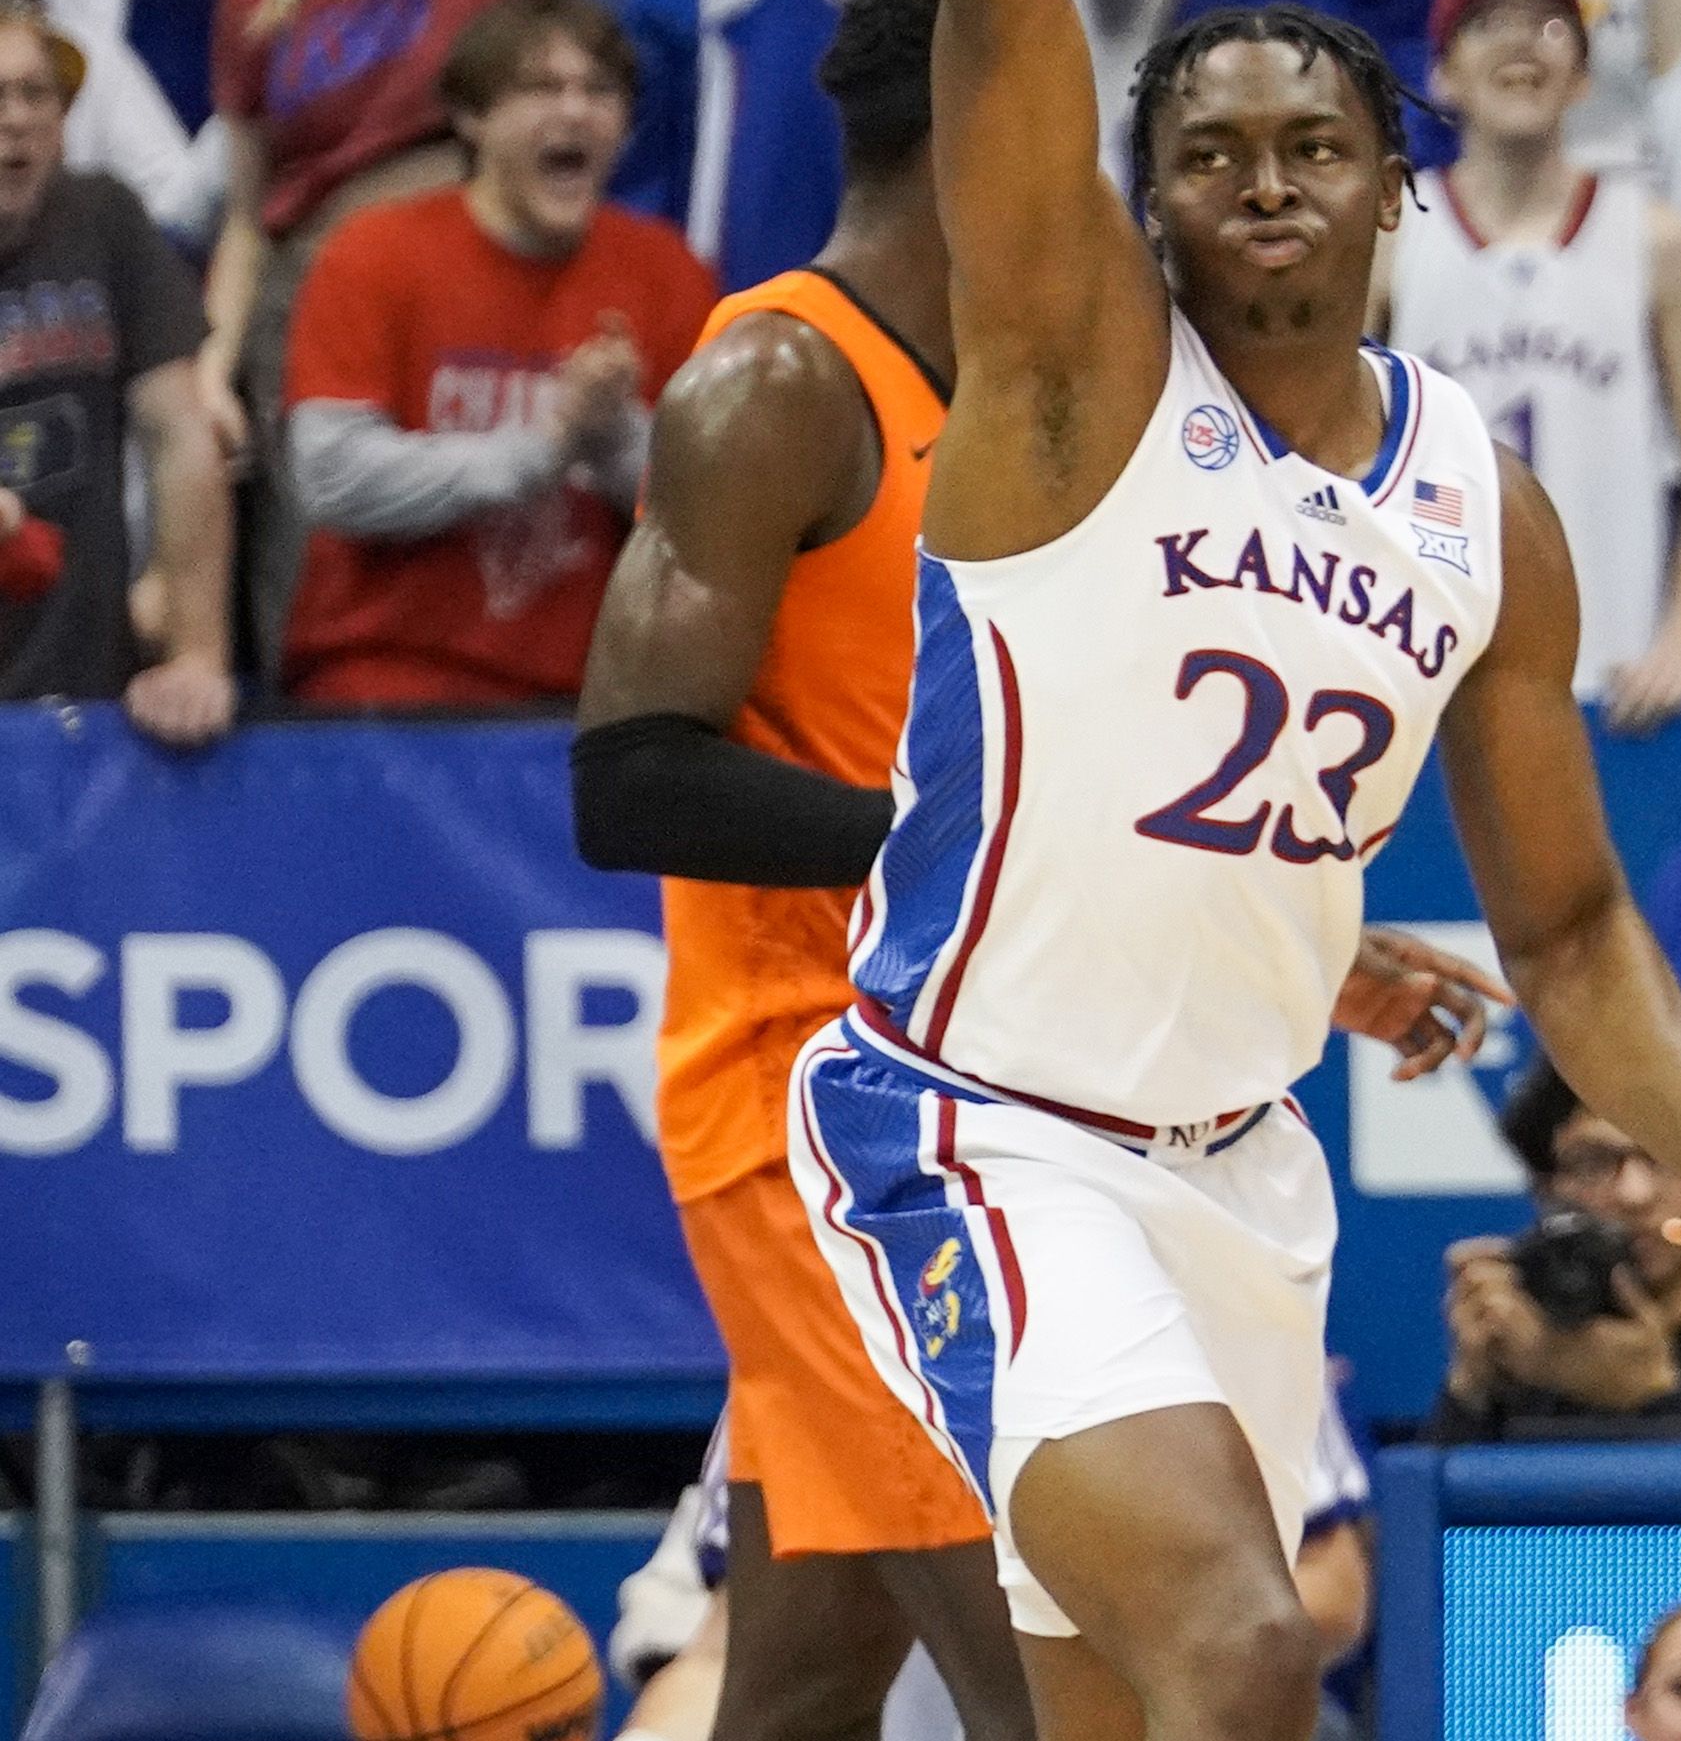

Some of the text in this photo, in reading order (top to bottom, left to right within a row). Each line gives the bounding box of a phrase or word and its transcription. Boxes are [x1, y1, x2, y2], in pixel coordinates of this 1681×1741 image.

[1154, 527, 1459, 680] KANSAS
[1133, 648, 1397, 865] 23
[0, 926, 668, 1157] SPOR
